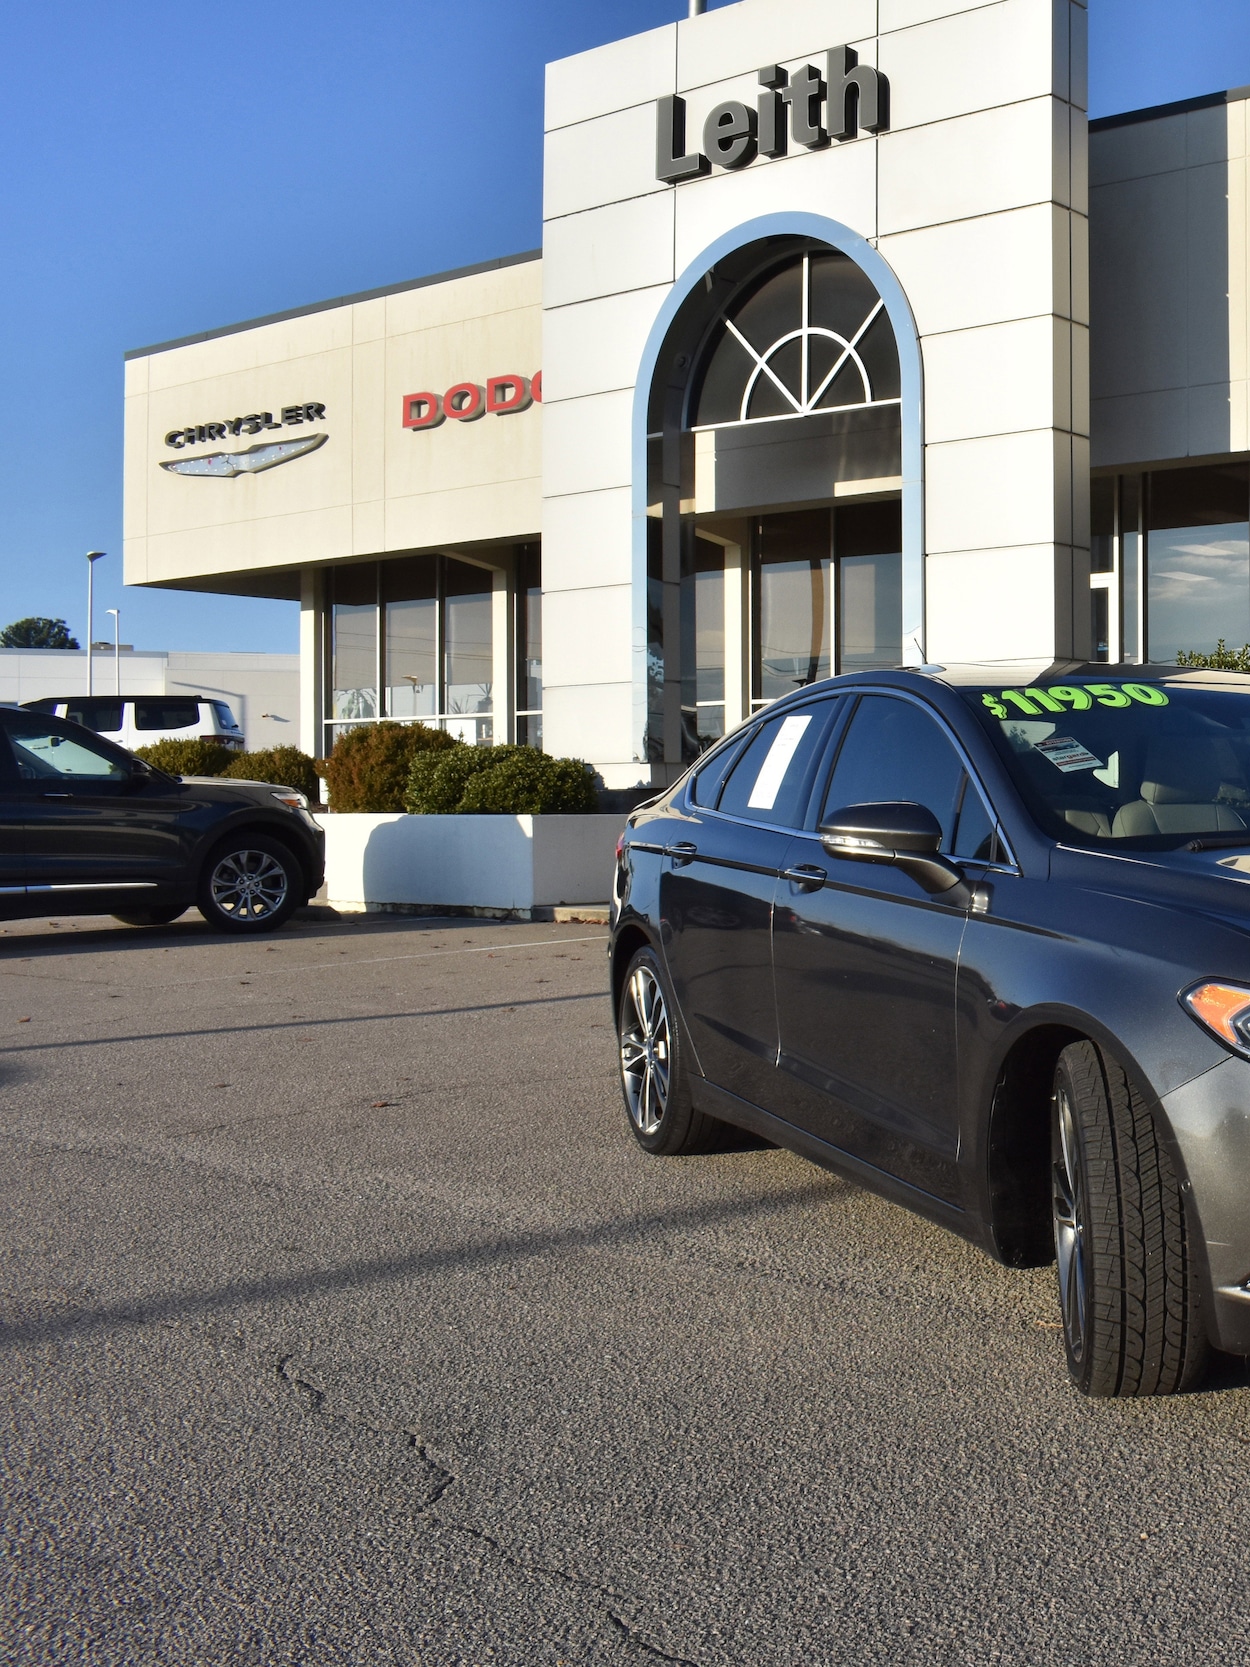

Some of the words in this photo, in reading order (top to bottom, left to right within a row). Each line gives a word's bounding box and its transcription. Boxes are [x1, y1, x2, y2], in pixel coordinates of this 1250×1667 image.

[655, 44, 891, 185] Leith
[164, 401, 327, 448] CHRYSLER
[982, 683, 1170, 720] $11950
